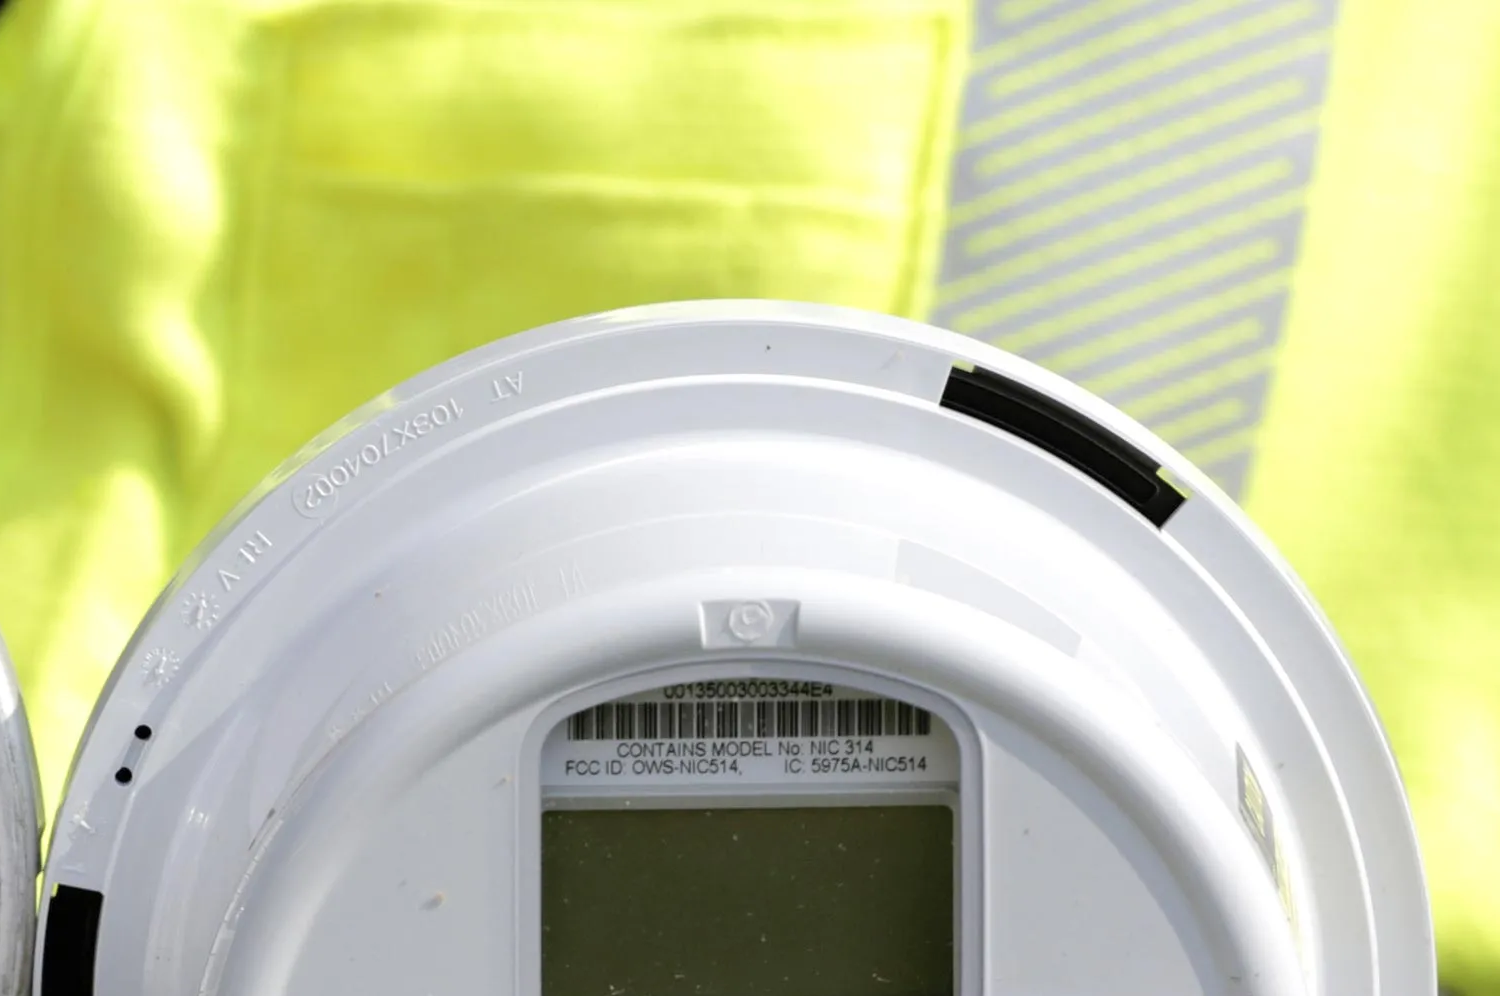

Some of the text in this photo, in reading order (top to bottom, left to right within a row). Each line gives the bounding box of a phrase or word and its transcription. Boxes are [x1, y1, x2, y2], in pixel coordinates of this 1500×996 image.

[489, 371, 525, 402] AT
[616, 740, 874, 759] CONTAINS MODEL No: NIC 314
[565, 757, 928, 777] FCC ID: OWS-NIC514, IC: 5975A-NIC514
